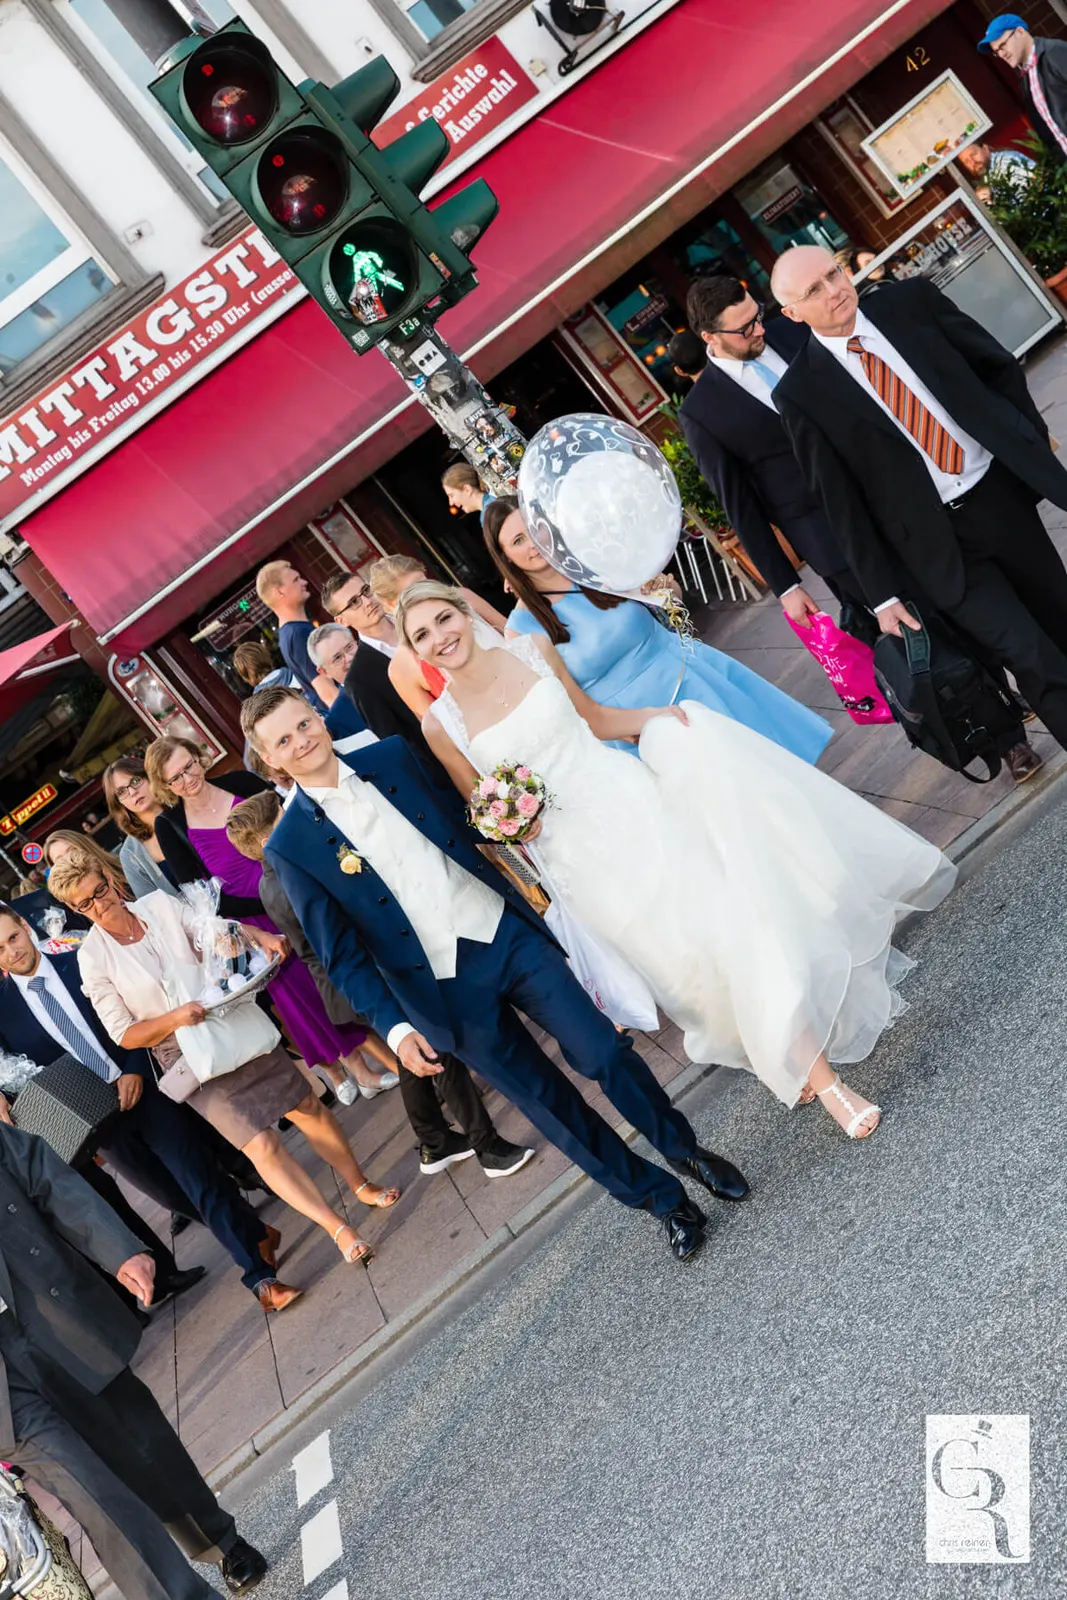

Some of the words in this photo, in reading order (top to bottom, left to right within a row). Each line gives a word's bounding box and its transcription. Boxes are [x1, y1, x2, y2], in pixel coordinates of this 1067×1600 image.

[905, 46, 931, 73] 42
[418, 64, 488, 123] Gerichte
[444, 69, 518, 143] Auswahl
[20, 445, 73, 487] Montag
[67, 429, 92, 449] bis
[88, 392, 139, 433] Freitag
[135, 363, 171, 395] 13.00
[167, 349, 192, 370] bis
[189, 320, 225, 353] 15.30
[222, 300, 251, 325] Uhr
[250, 268, 296, 305] (ausse
